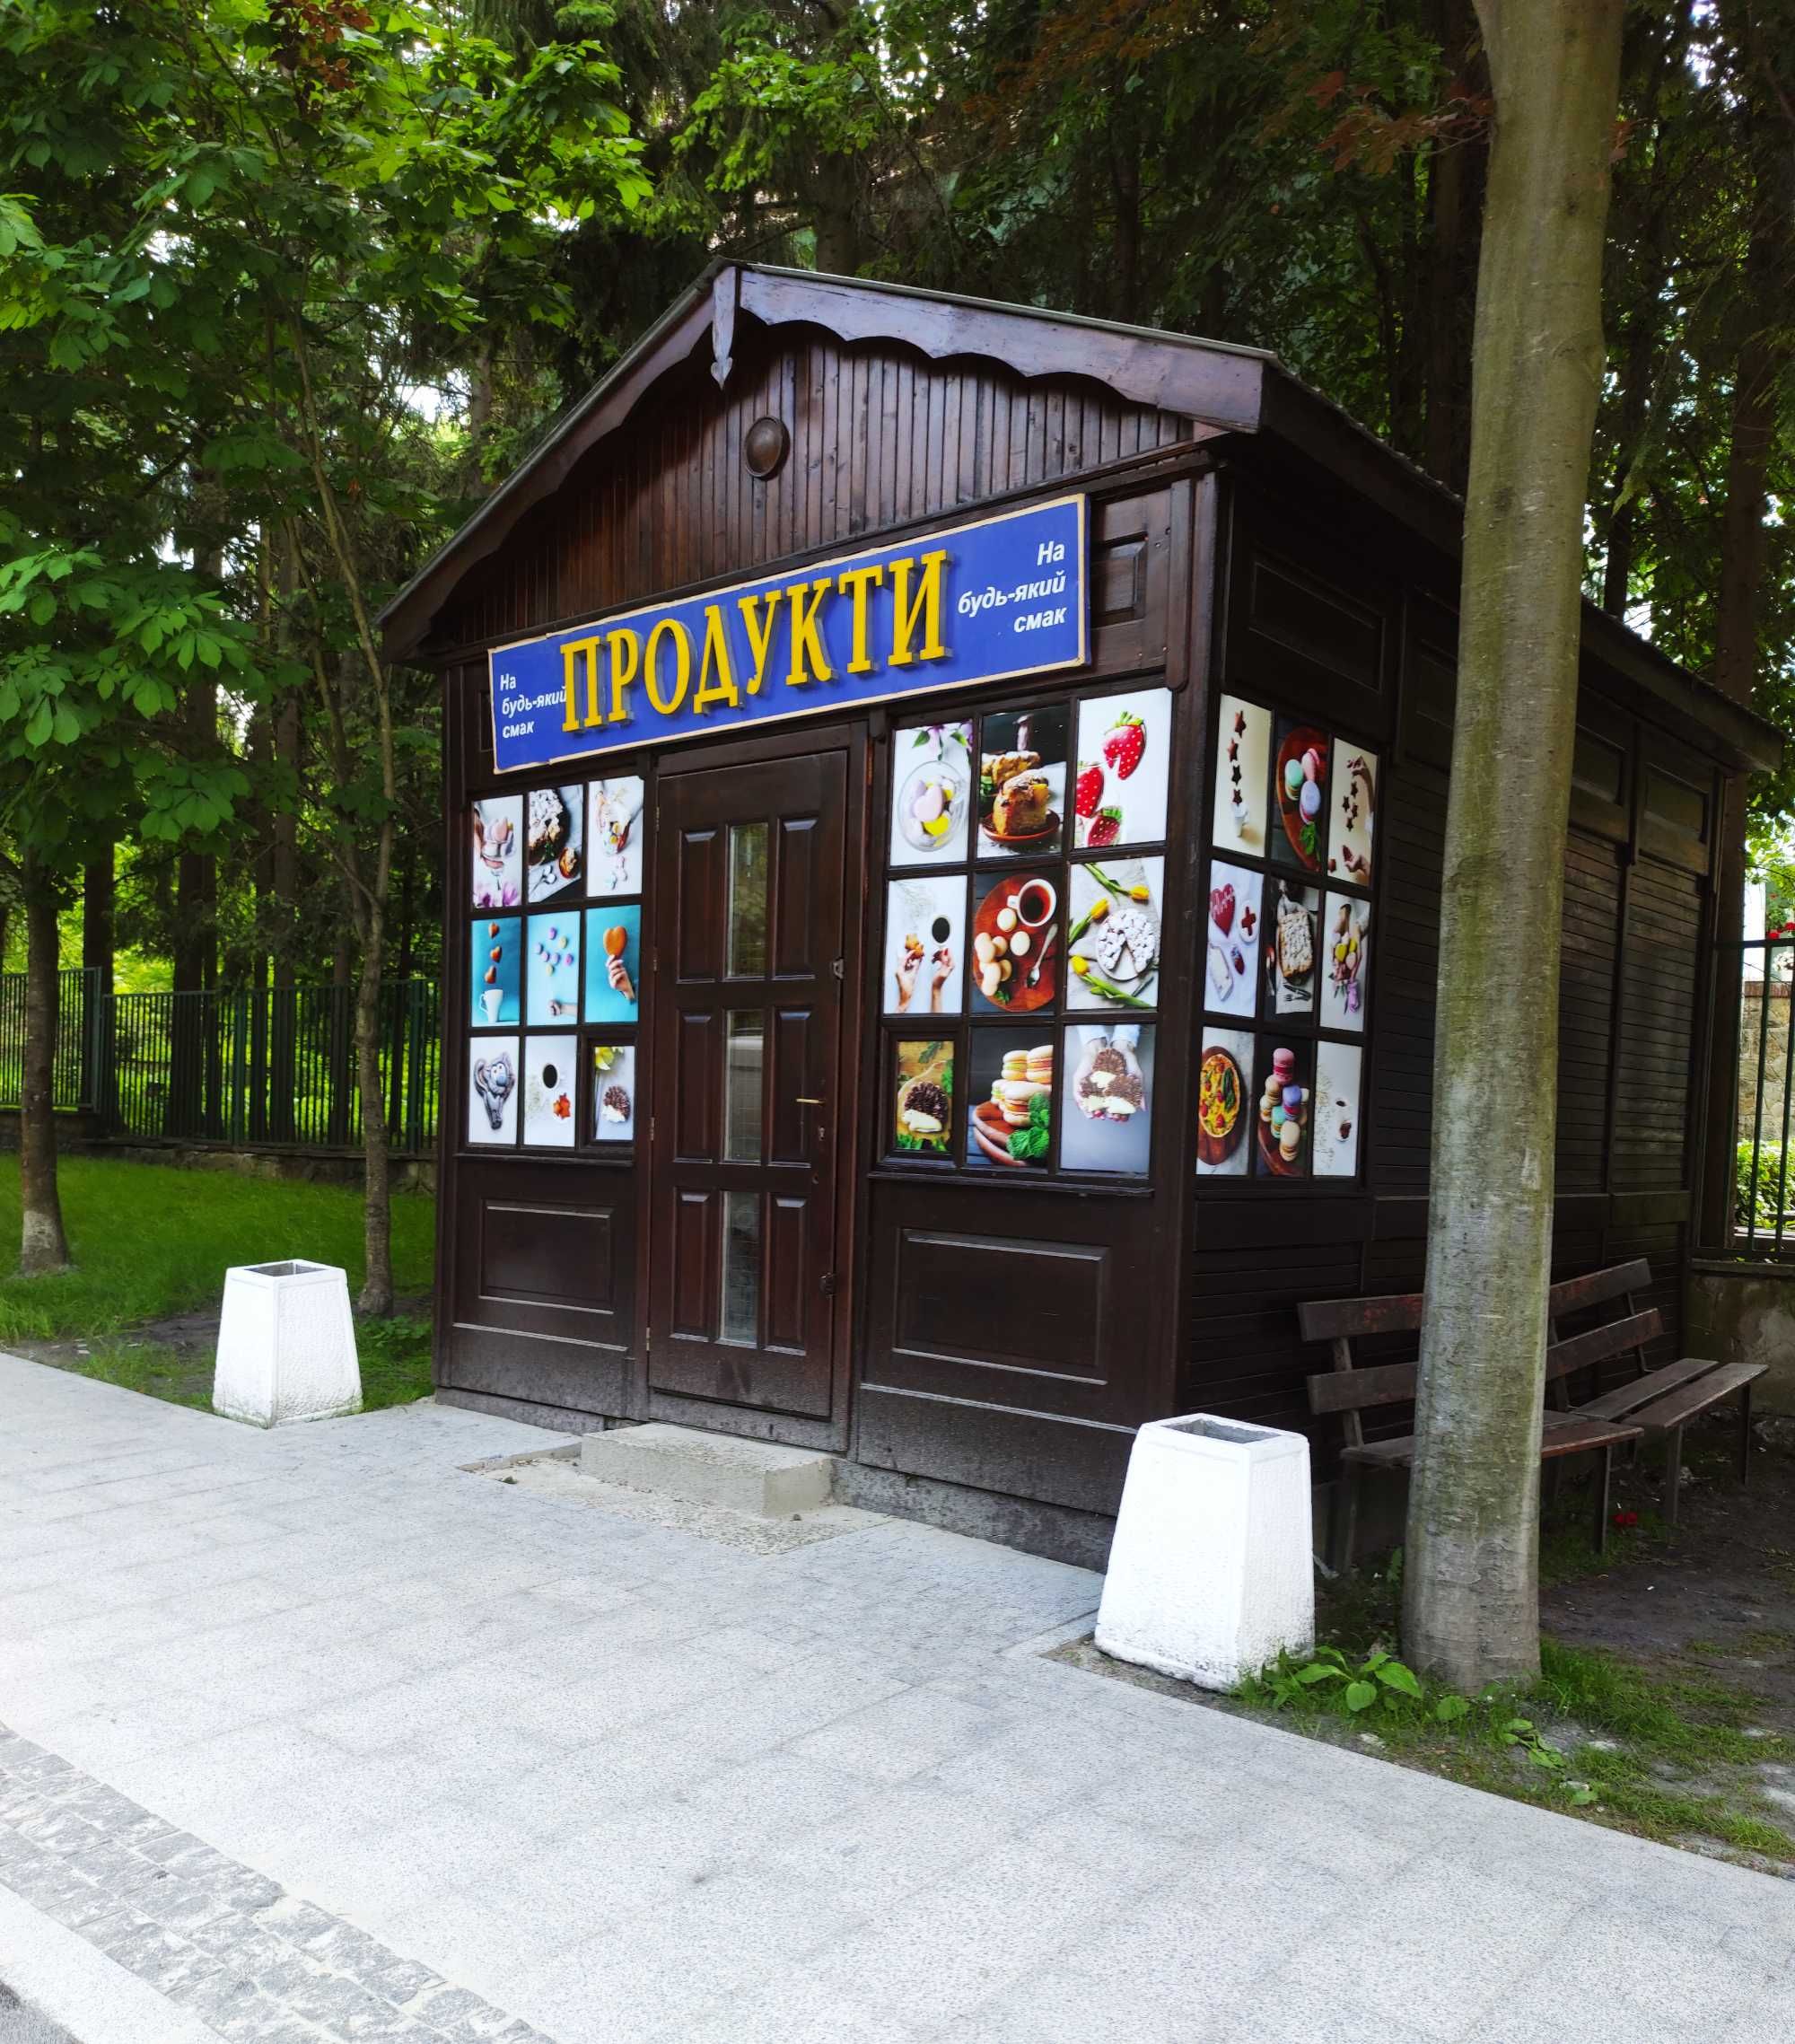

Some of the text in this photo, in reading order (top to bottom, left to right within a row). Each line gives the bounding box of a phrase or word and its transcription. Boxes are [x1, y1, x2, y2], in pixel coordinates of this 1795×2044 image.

[1037, 540, 1065, 566] На
[958, 570, 1066, 618] будь-який
[1014, 607, 1067, 633] смак
[561, 549, 948, 732] ПРОДУКТИ
[500, 673, 516, 690] На
[502, 686, 566, 719] будь-який
[502, 721, 535, 739] смак
